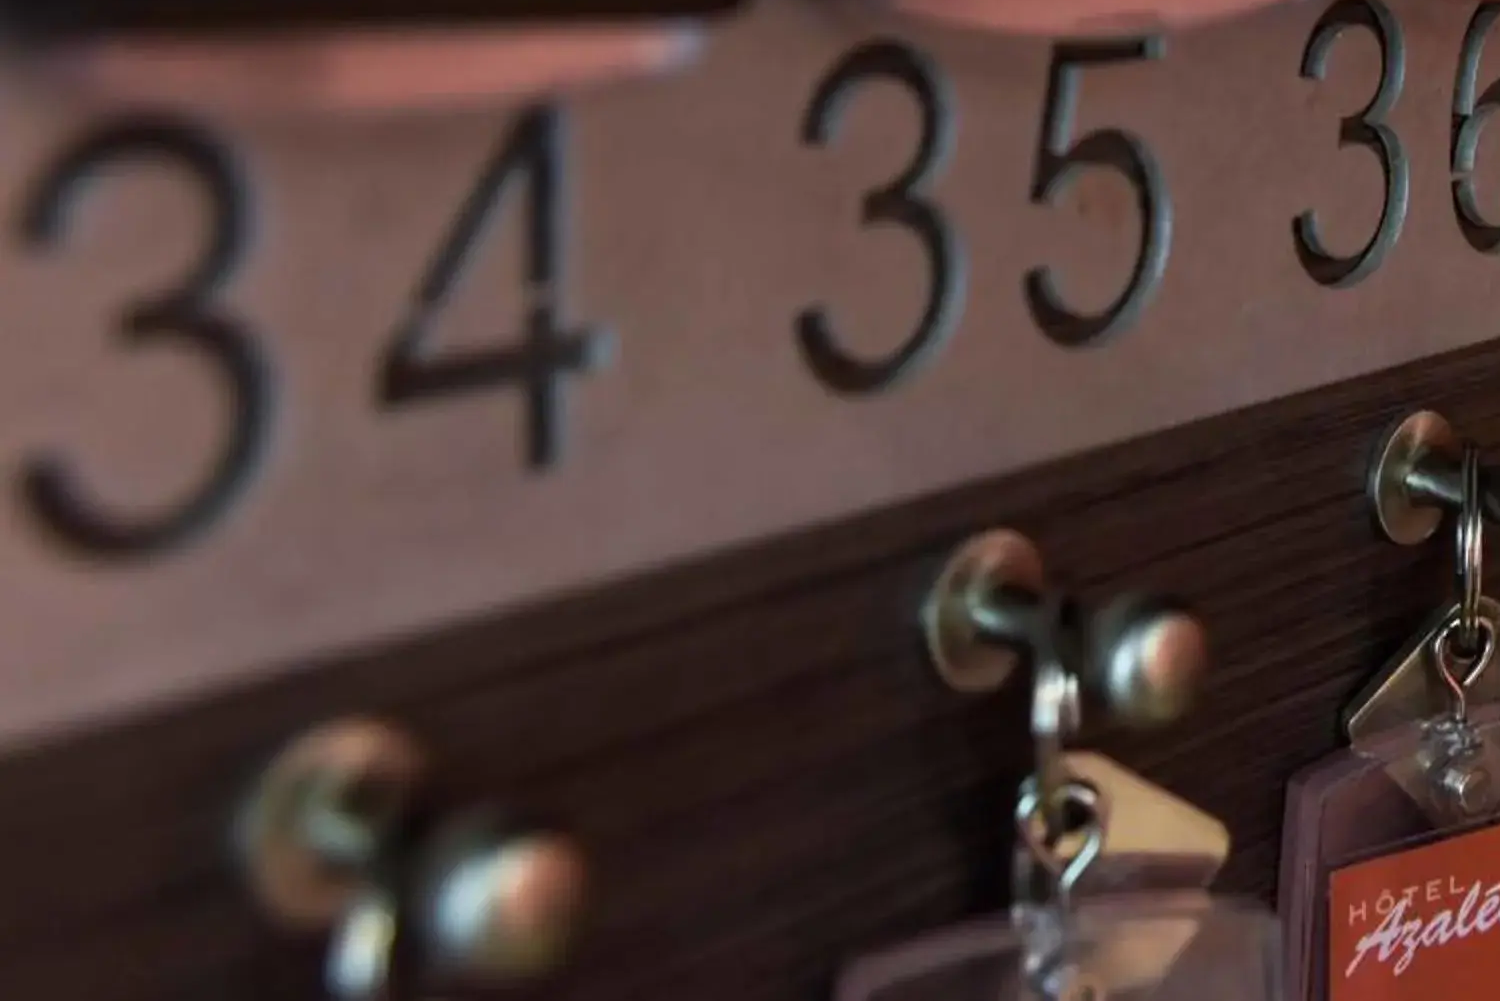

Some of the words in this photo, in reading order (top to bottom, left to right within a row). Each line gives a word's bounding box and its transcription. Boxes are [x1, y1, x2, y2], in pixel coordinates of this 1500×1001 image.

[14, 97, 614, 567] 34
[794, 34, 1173, 396] 35
[1349, 875, 1466, 926] HÔTEL
